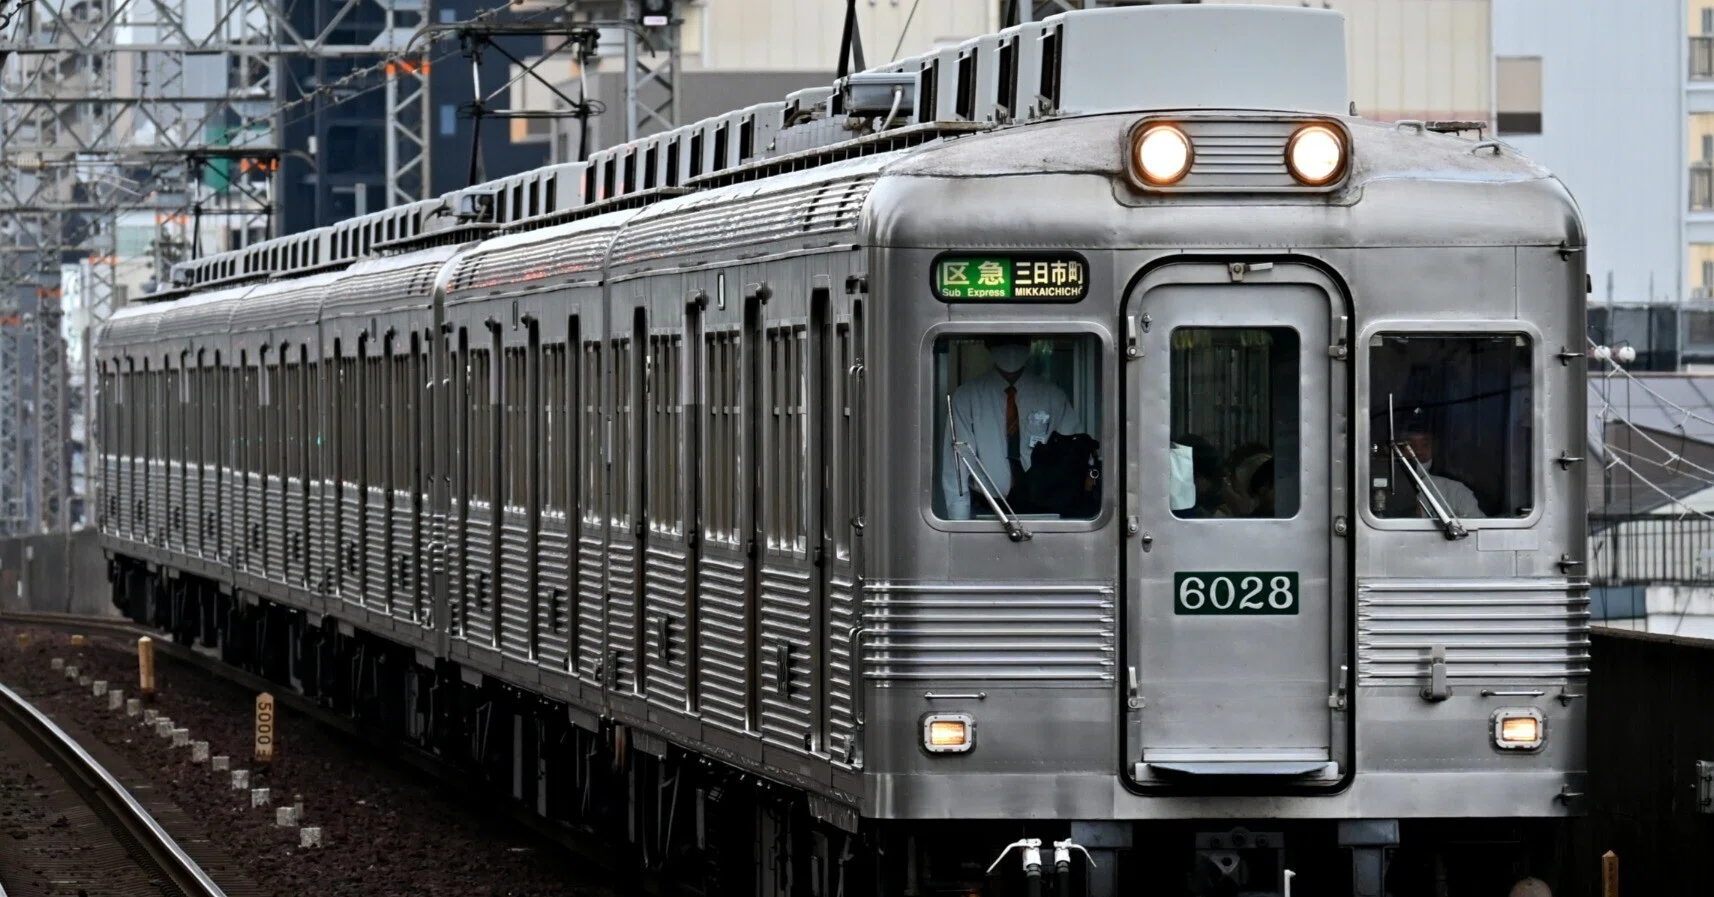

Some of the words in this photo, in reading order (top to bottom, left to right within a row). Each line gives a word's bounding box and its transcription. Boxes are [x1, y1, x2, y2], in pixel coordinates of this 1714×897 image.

[943, 261, 1005, 286] 区急
[1015, 260, 1083, 286] 三日市町
[942, 288, 961, 297] Sub
[967, 287, 1005, 298] Express
[1180, 576, 1293, 609] 6028
[258, 702, 272, 744] 5000
